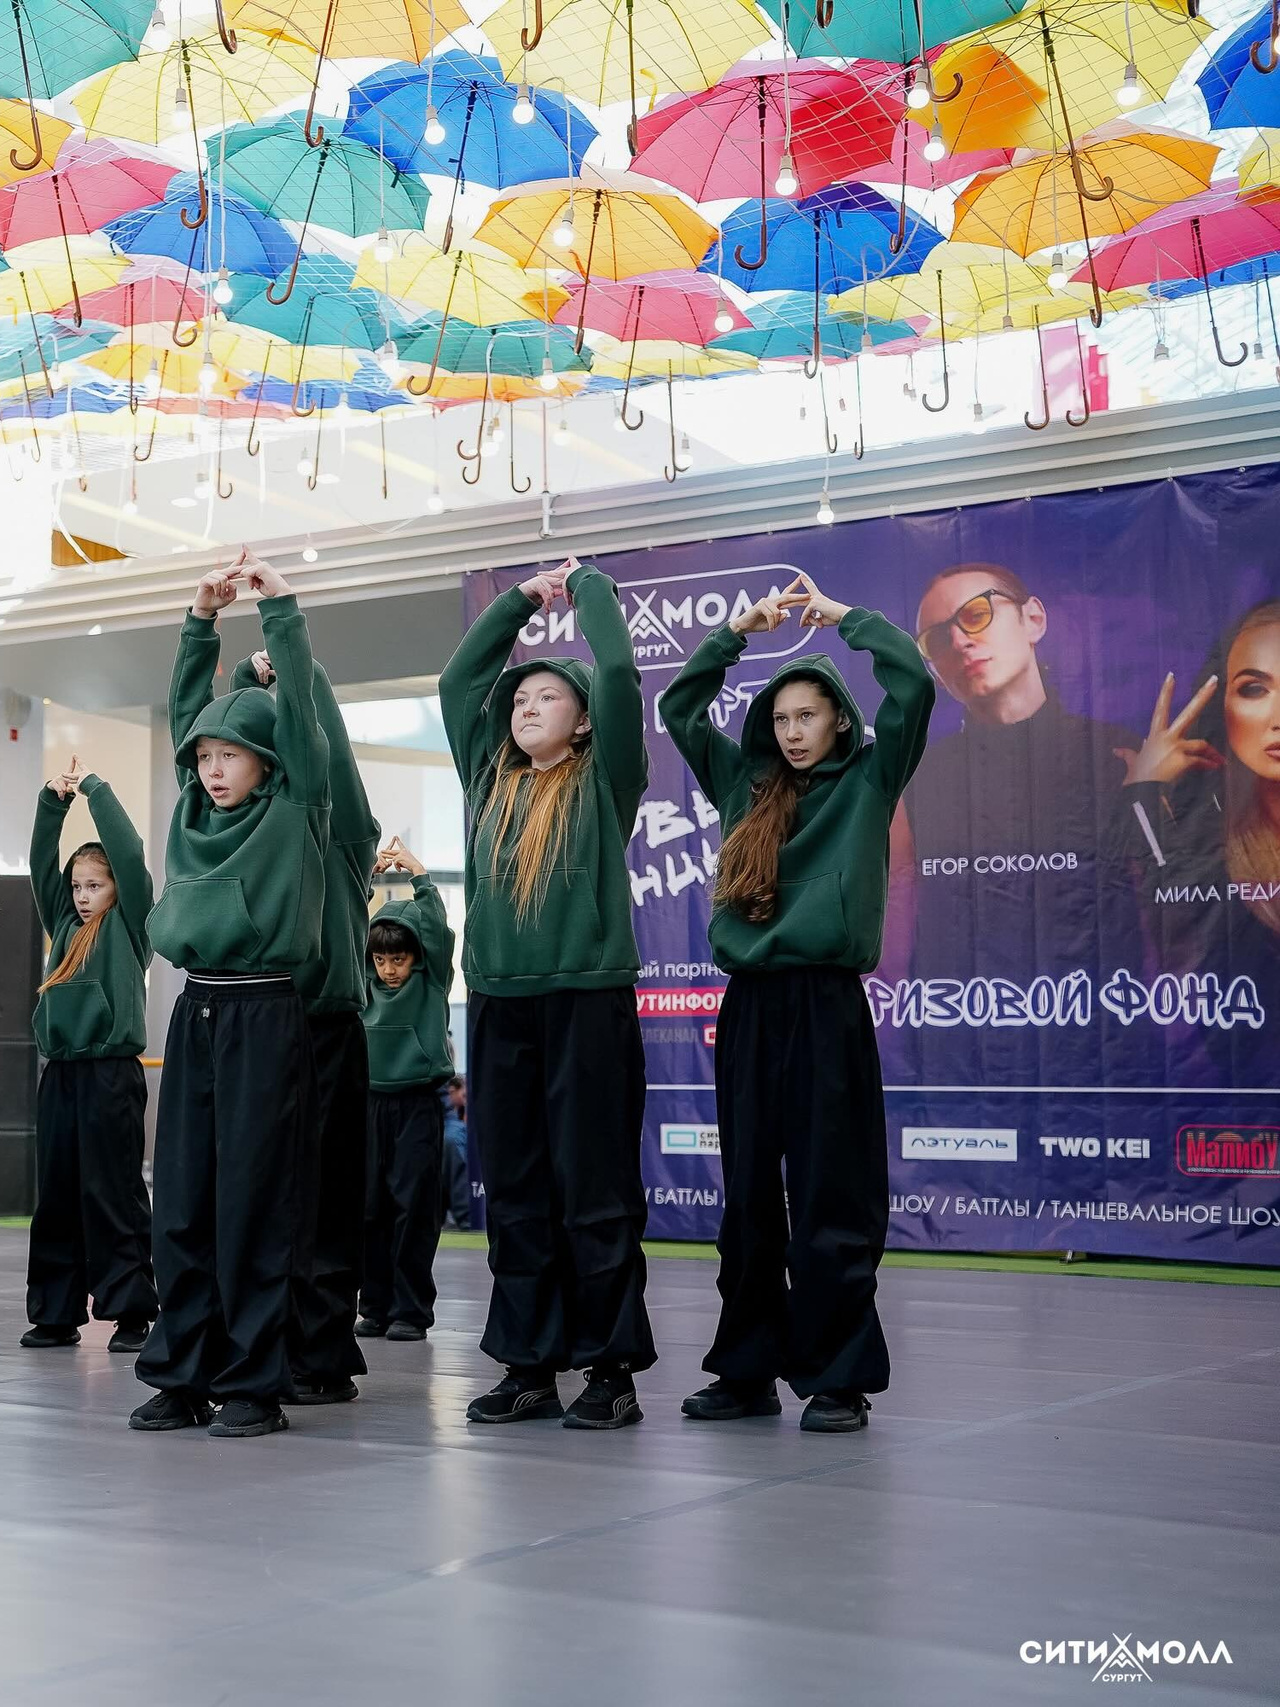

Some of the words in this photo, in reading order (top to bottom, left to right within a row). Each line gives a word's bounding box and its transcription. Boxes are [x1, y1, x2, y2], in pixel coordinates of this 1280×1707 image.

[922, 857, 969, 876] ЕГОР
[973, 852, 1078, 874] СОКОЛОВ
[1155, 884, 1221, 903] МИЛА
[1099, 968, 1265, 1030] ФОНД
[1039, 1136, 1101, 1159] TWO
[1107, 1138, 1151, 1159] KEI
[654, 1186, 718, 1206] БАТТЛЫ
[955, 1197, 1031, 1218] БАТТЛЫ
[1051, 1200, 1222, 1224] ТАНЦЕВАЛЬНОЕ
[1228, 1205, 1280, 1227] ШОУ
